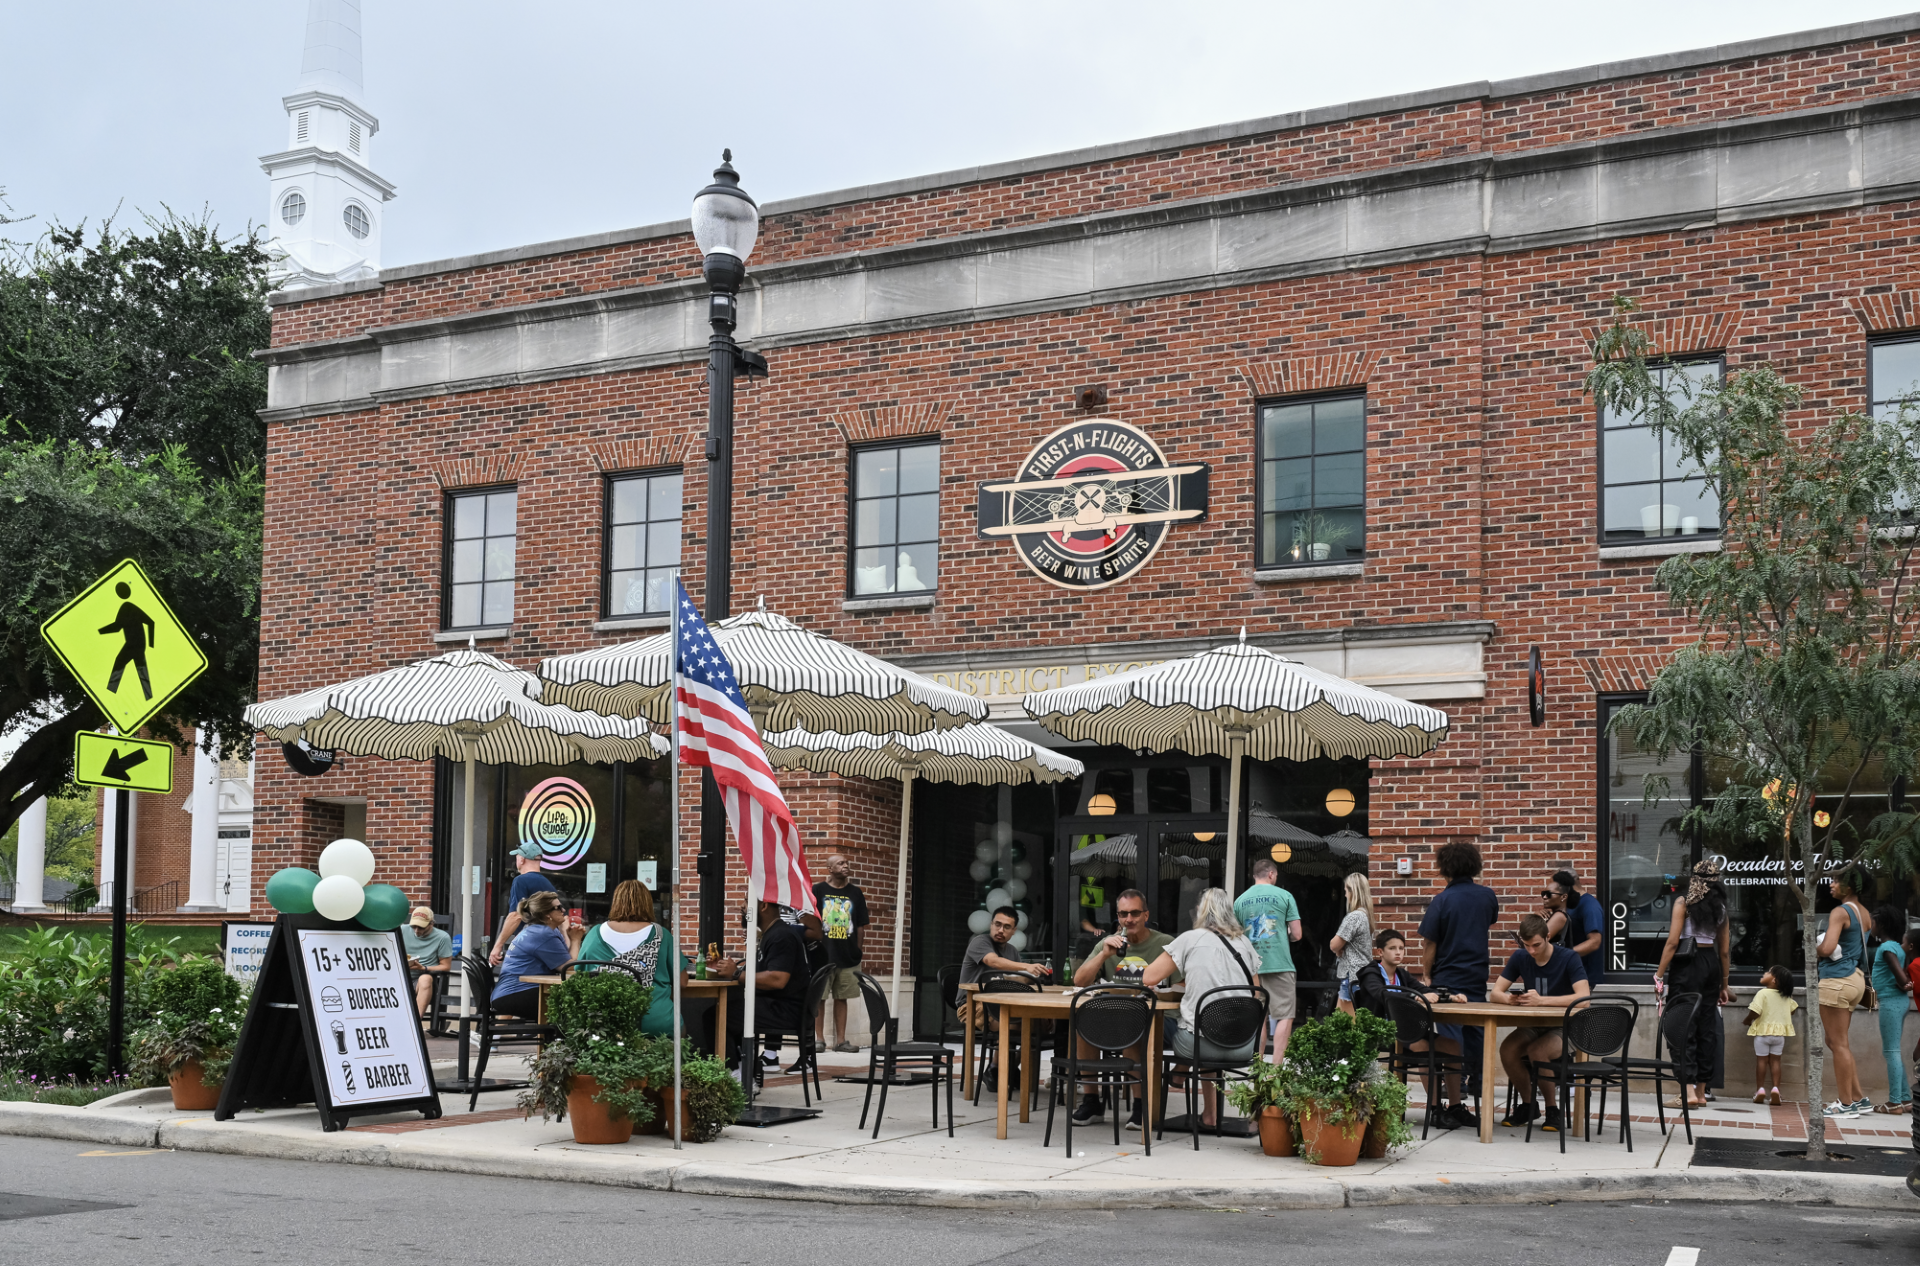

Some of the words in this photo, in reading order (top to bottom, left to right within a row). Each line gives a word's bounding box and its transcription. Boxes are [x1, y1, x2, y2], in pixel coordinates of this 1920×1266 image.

[1028, 429, 1155, 480] FIRST-N-FLIGHTS
[1030, 545, 1060, 574] BEER
[1063, 565, 1101, 580] WINE
[1104, 537, 1150, 576] SPIRITS
[932, 666, 1069, 697] DISTRICT
[310, 750, 333, 759] CRANE
[1723, 877, 1788, 886] CELEBRATING
[236, 929, 271, 938] COFFEE
[1612, 902, 1627, 970] OPEN
[311, 947, 342, 972] 15+
[345, 947, 392, 971] SHOPS
[346, 987, 400, 1010] BURGERS
[355, 1026, 390, 1050] BEER
[364, 1063, 412, 1089] BARBER
